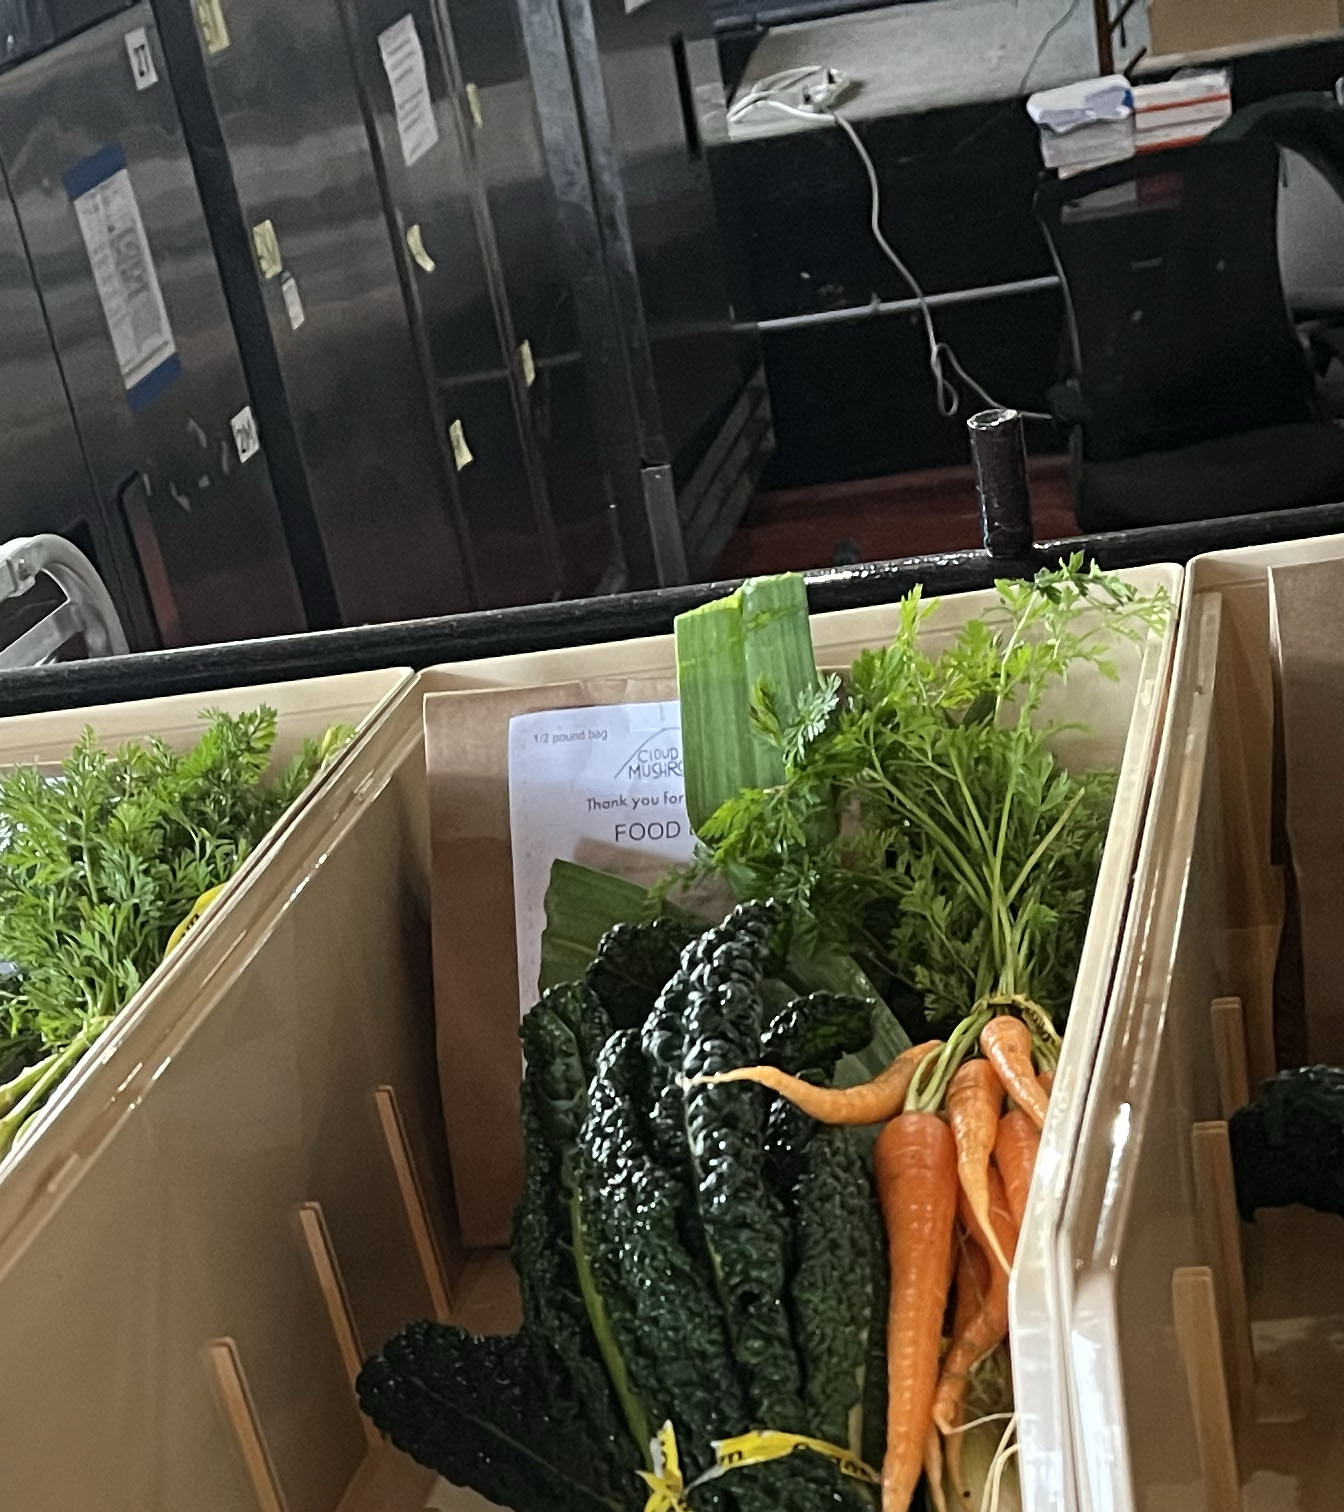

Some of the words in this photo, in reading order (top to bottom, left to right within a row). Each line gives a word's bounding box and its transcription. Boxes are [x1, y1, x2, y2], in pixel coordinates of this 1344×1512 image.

[552, 731, 586, 742] pound
[588, 730, 608, 741] bag
[587, 794, 627, 811] Thank
[632, 796, 659, 810] you
[664, 791, 684, 805] for
[615, 821, 681, 842] FOOD
